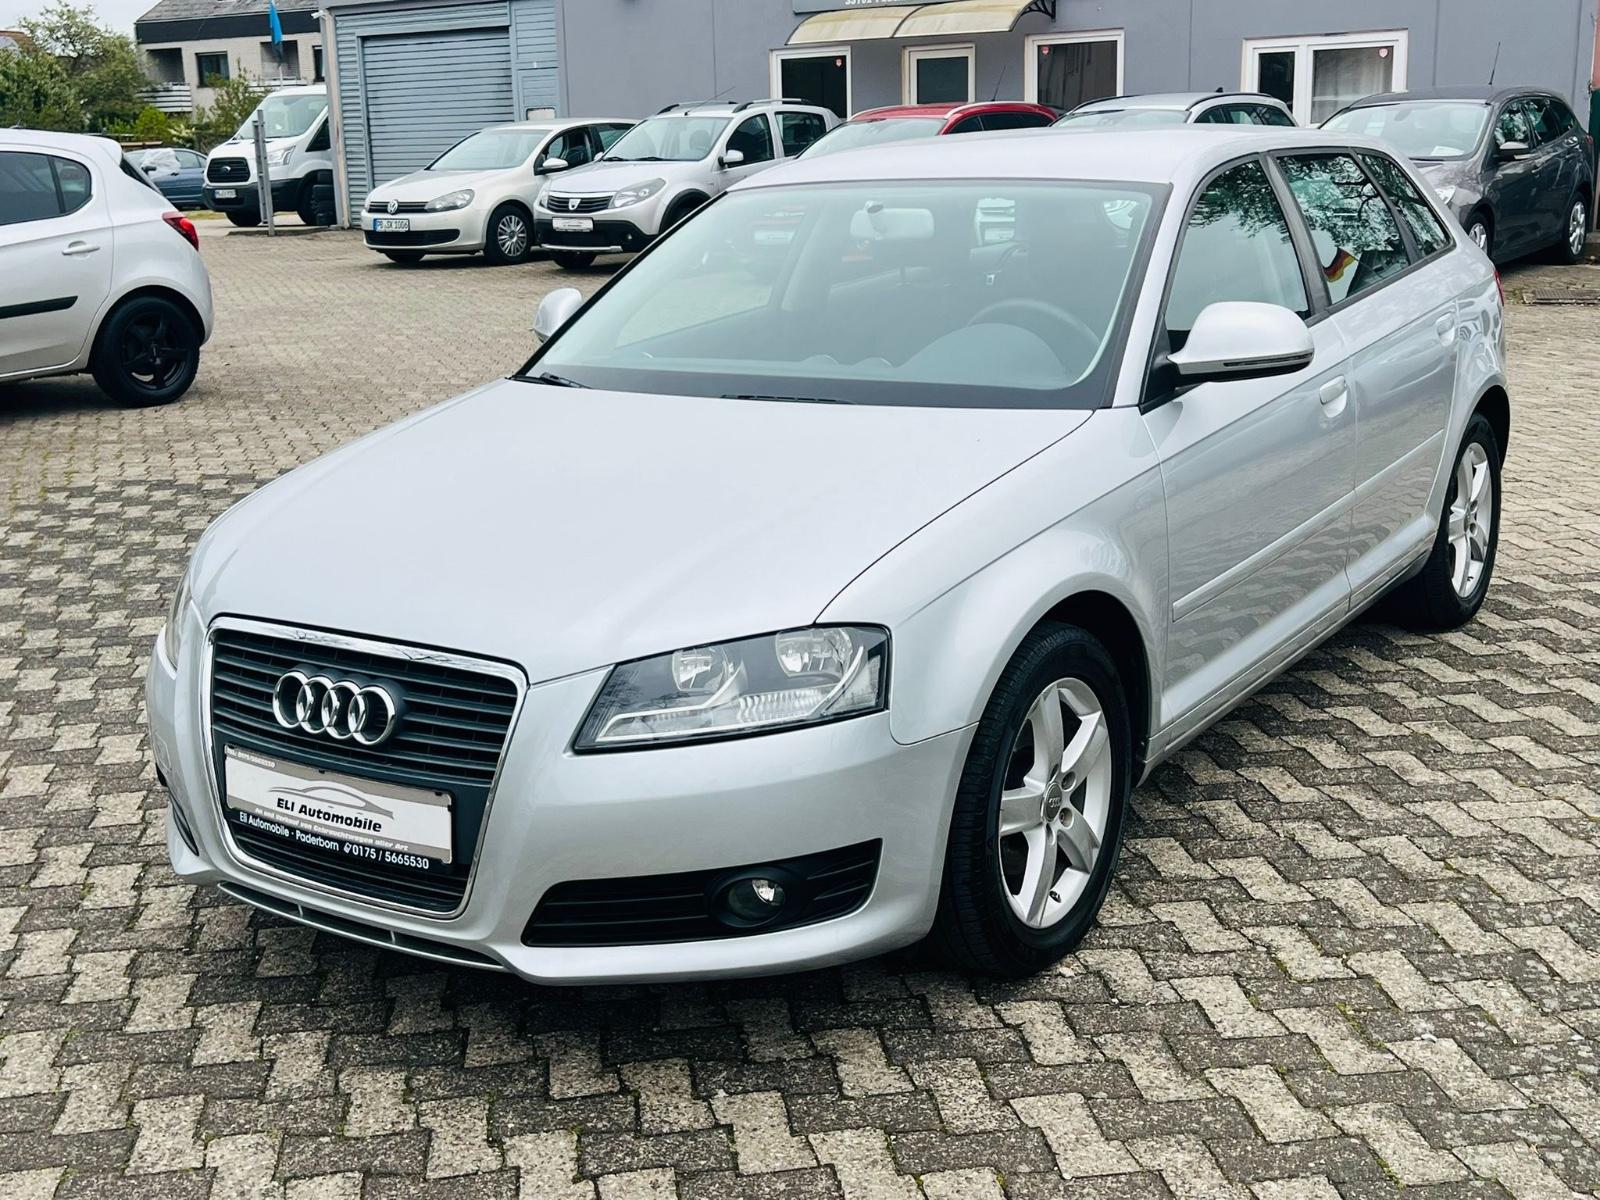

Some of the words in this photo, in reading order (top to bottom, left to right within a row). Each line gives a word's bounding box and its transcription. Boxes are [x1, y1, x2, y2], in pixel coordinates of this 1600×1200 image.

[277, 797, 295, 812] ELI
[298, 804, 382, 832] Automobile
[239, 811, 248, 822] Eli
[248, 814, 290, 837] Automobile
[295, 829, 339, 851] Paderborn
[352, 844, 377, 859] 0175
[384, 851, 430, 870] 5665530
[374, 838, 393, 848] aller
